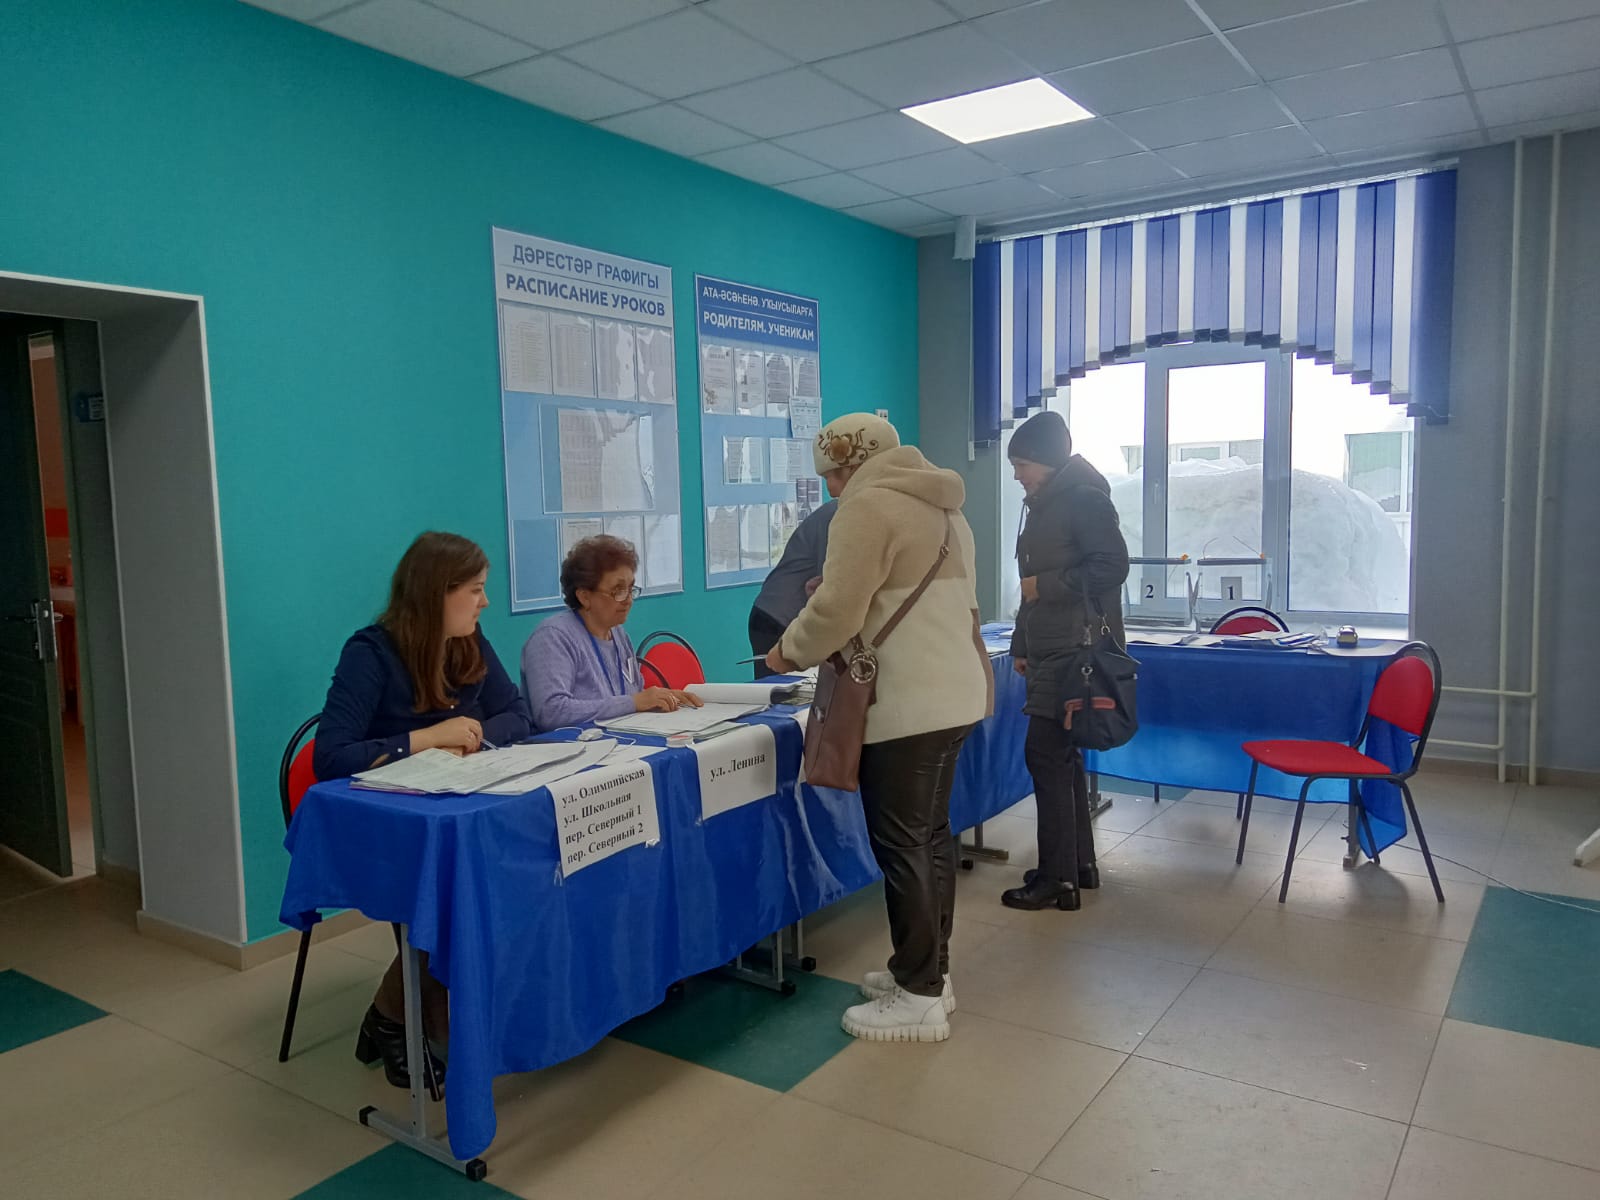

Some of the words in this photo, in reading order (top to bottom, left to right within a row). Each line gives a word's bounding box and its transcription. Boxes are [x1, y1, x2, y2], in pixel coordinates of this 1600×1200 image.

[513, 244, 593, 275] ДӘРЕСТӘР
[597, 262, 659, 289] ГРАФИГЫ
[506, 273, 609, 306] РАСПИСАНИЕ
[611, 293, 665, 316] УРОКОВ
[768, 322, 815, 341] УЧЕНИКАМ
[1145, 584, 1154, 598] 2
[1227, 585, 1234, 600] 1
[710, 767, 726, 782] ул.
[728, 753, 766, 774] Ленина
[561, 794, 578, 808] ул.
[579, 768, 645, 799] Олимпийская
[563, 814, 579, 828] ул.
[581, 791, 632, 820] Школьная
[565, 829, 585, 845] пер.
[587, 809, 635, 836] Северный
[637, 804, 642, 815] 1
[567, 849, 586, 865] пер.
[588, 828, 636, 854] Северный
[637, 822, 644, 834] 2
